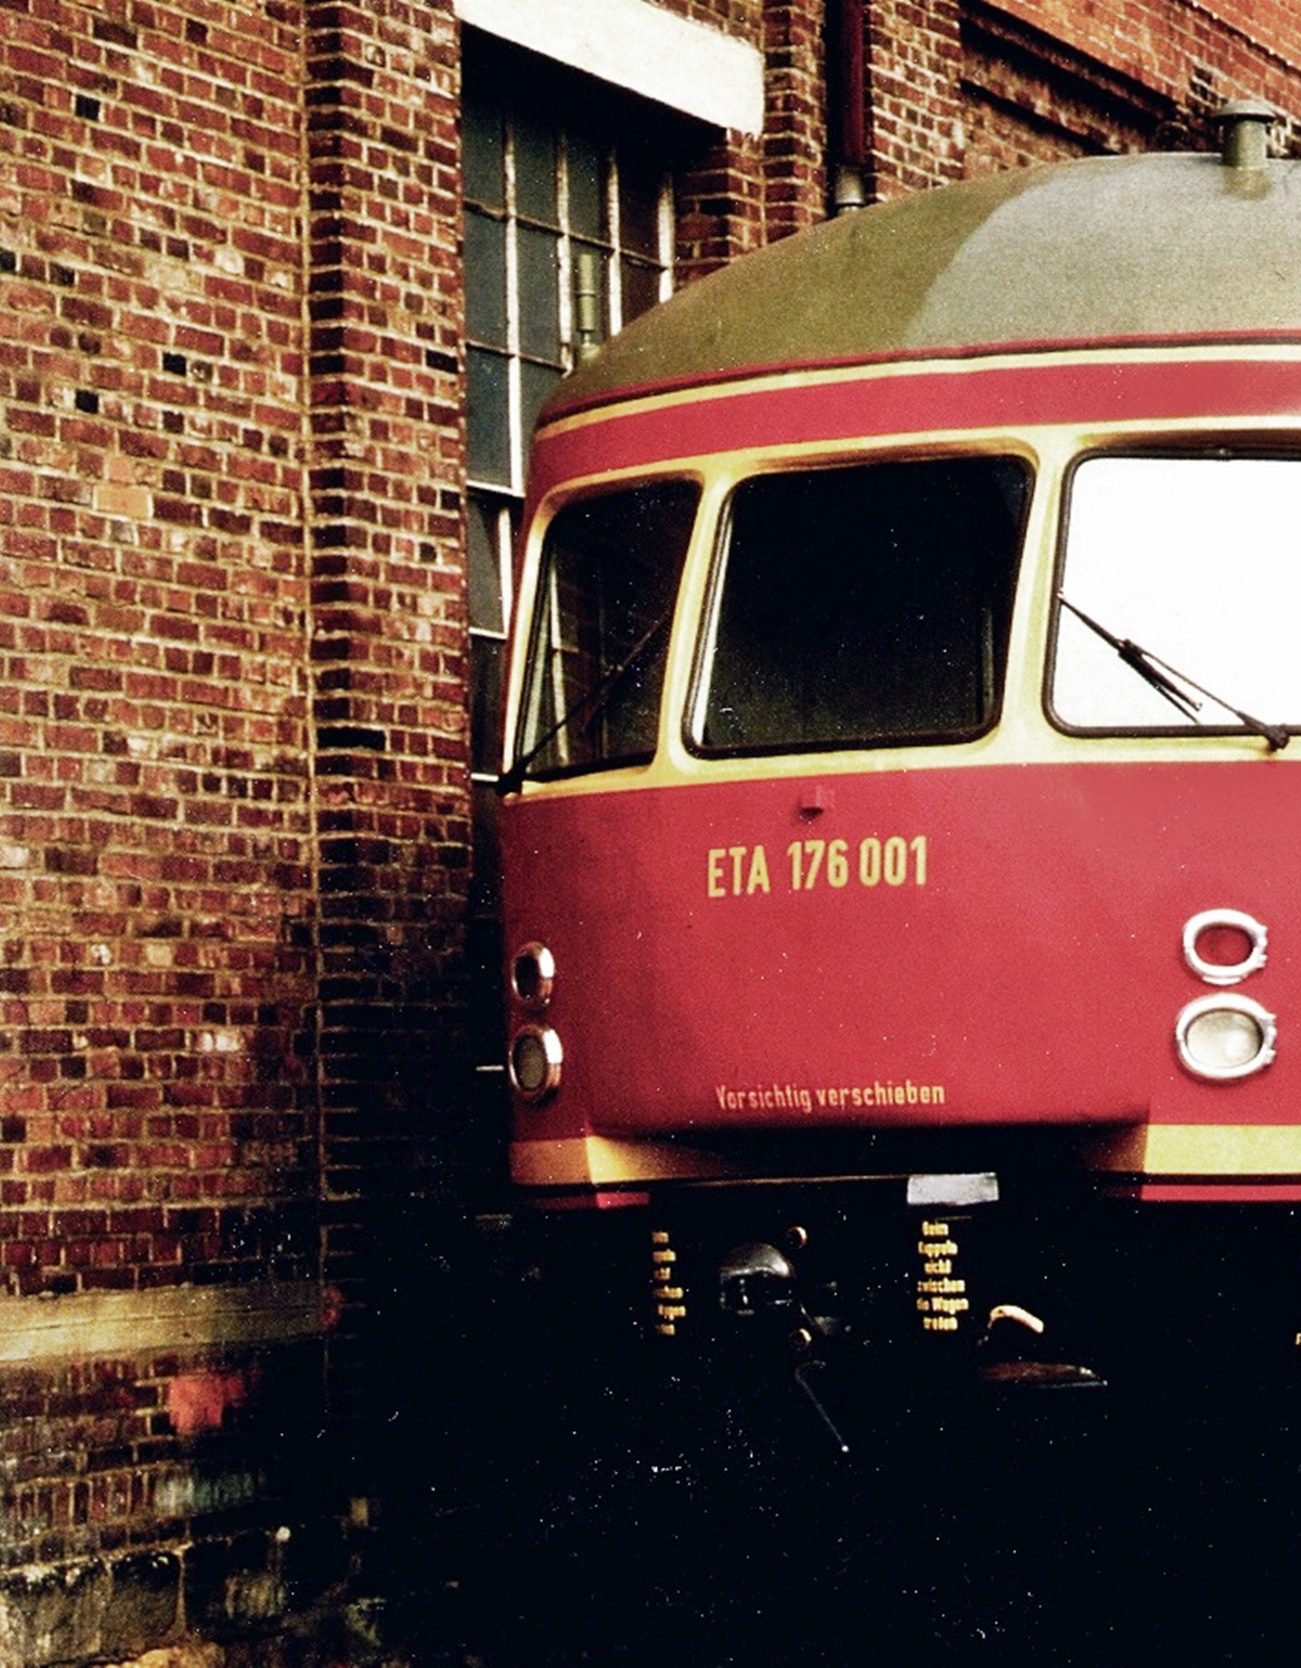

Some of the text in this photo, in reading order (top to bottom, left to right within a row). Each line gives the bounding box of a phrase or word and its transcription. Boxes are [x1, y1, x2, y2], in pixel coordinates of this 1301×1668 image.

[707, 835, 927, 897] ETA 176 001
[716, 1079, 945, 1113] Vorsichtig verschieben
